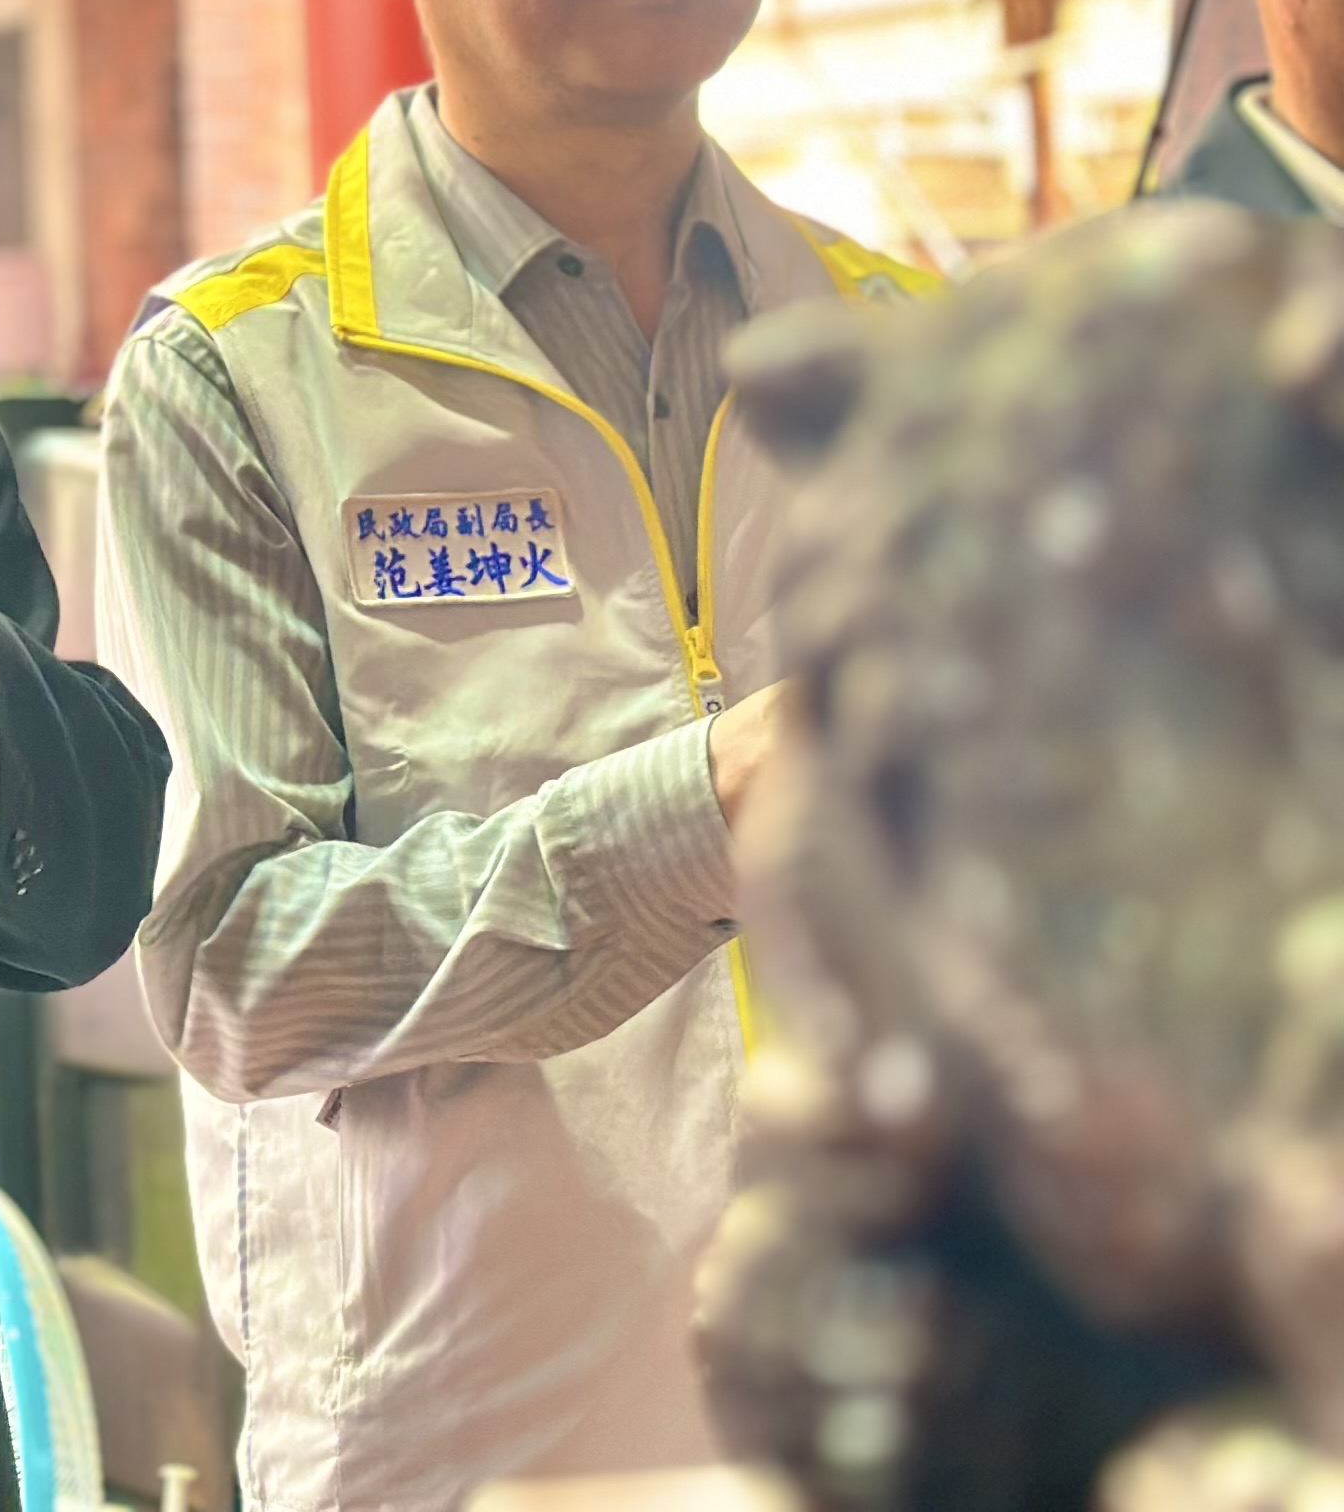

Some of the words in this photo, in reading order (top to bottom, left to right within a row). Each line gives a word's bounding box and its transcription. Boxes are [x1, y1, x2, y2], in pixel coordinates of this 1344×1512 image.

[357, 497, 555, 540] 民政局副局長
[373, 540, 569, 599] 范姜坤火
